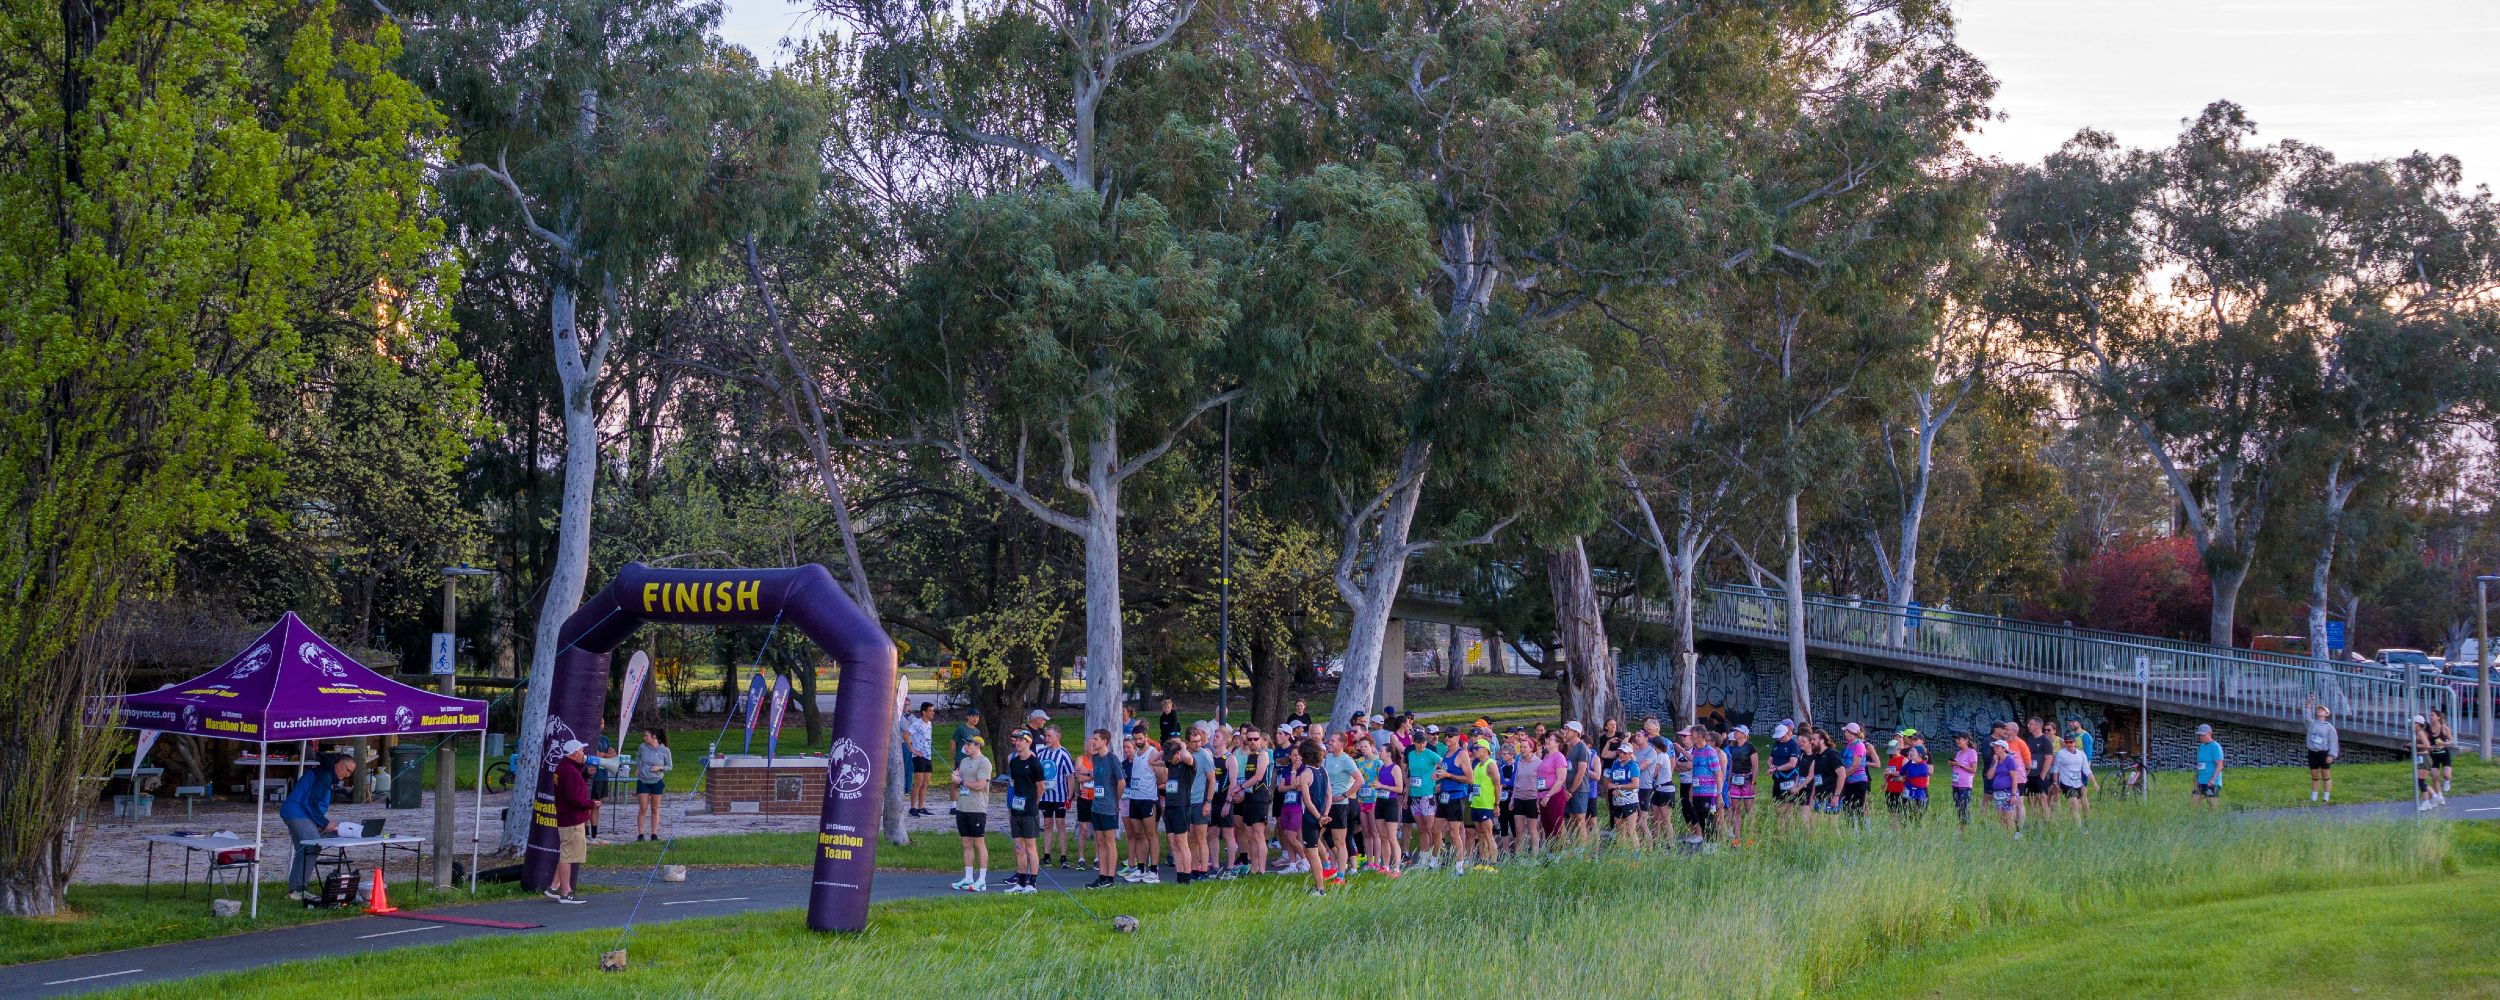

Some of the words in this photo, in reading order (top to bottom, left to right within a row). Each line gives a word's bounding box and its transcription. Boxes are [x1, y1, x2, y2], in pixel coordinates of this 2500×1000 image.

[643, 580, 761, 612] FINISH
[360, 688, 387, 696] Team
[206, 717, 239, 732] Marathon
[240, 721, 258, 733] Team
[274, 714, 387, 729] au.srichinmoyraces.org
[421, 714, 458, 726] Marathon
[459, 713, 479, 724] Team
[840, 791, 862, 800] RACES
[833, 824, 856, 832] Chinmoy
[820, 832, 863, 848] Marathon
[825, 846, 852, 860] Team
